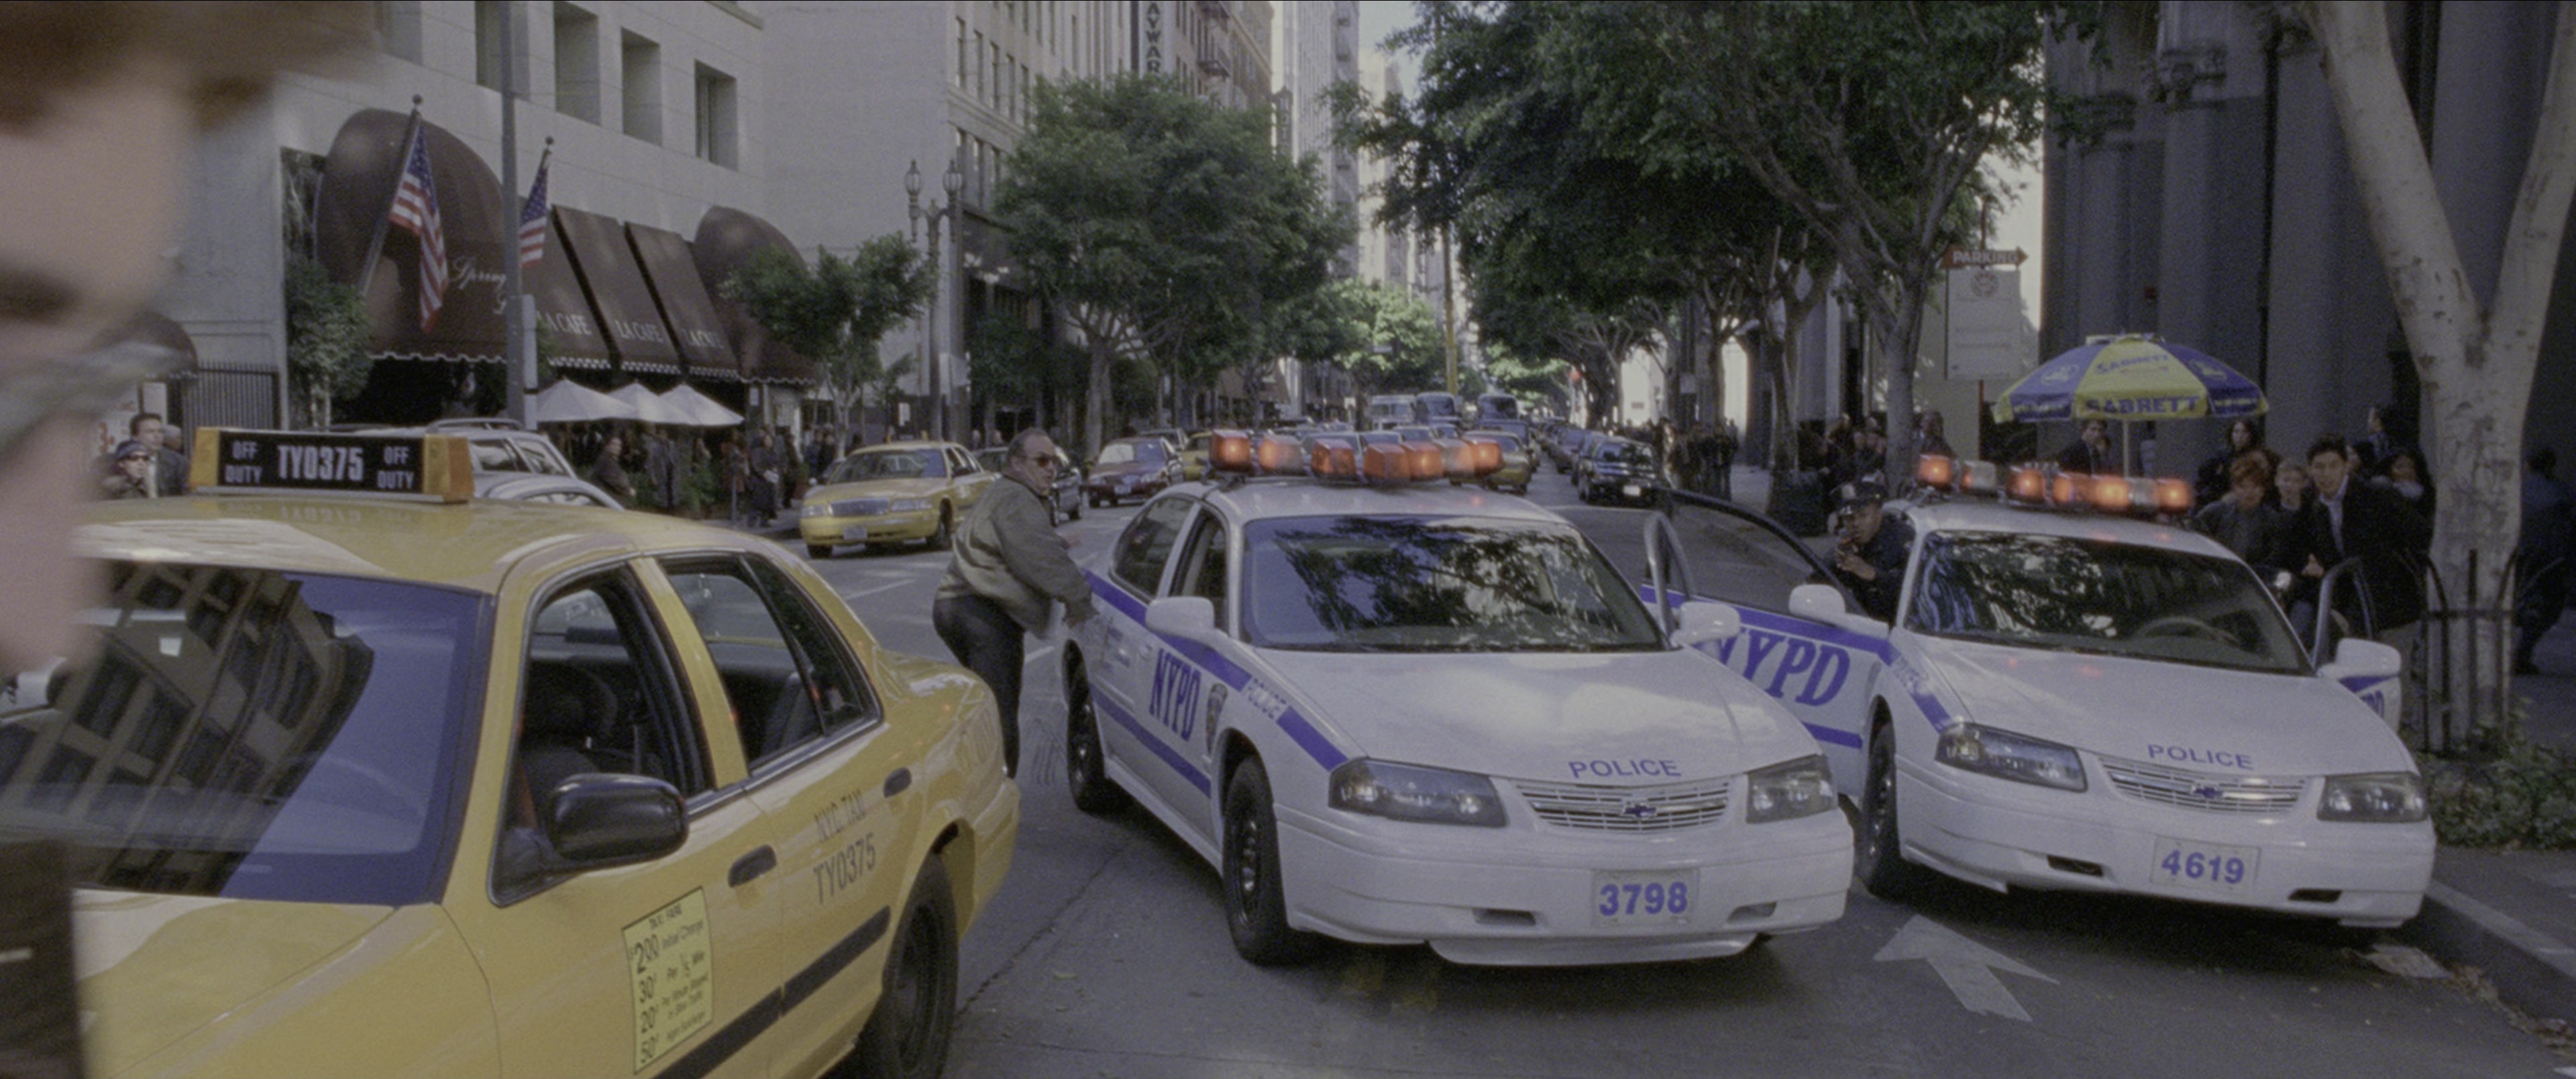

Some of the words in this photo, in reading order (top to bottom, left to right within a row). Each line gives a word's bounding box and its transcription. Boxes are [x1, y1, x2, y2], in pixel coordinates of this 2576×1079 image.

[232, 440, 259, 460] OFF
[383, 446, 409, 466] OFF
[225, 464, 262, 484] DUTY
[277, 444, 364, 482] TY0375
[376, 470, 415, 490] DUTY
[1149, 648, 1202, 741] NYPD
[2147, 743, 2253, 770] POLICE
[1568, 759, 1682, 778] POLICE
[2161, 849, 2245, 884] 4619
[1599, 881, 1688, 917] 3798
